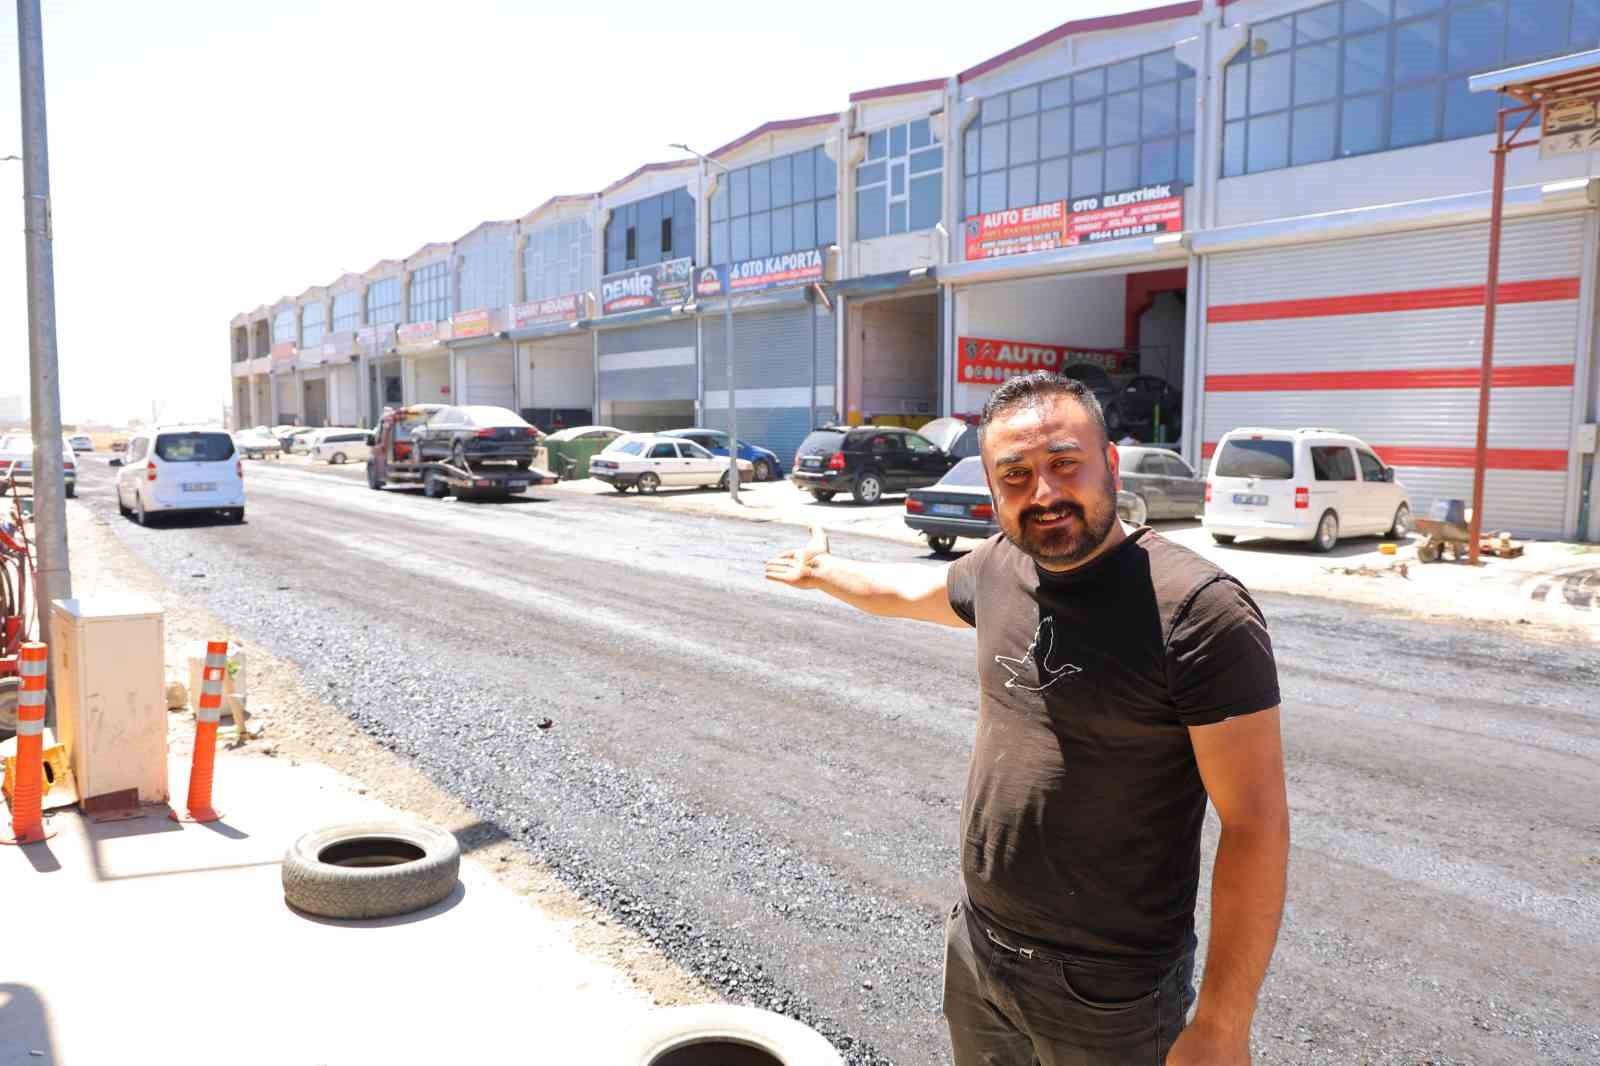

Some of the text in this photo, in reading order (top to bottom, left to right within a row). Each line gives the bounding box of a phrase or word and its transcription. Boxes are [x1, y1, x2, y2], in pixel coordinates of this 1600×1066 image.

[983, 210, 1019, 229] AUTO
[1023, 202, 1061, 222] EMRE
[1072, 198, 1098, 212] OTO
[741, 261, 764, 278] OTO
[766, 249, 822, 273] KAPORTA
[602, 271, 653, 301] DEMİR
[997, 345, 1057, 366] AUTO
